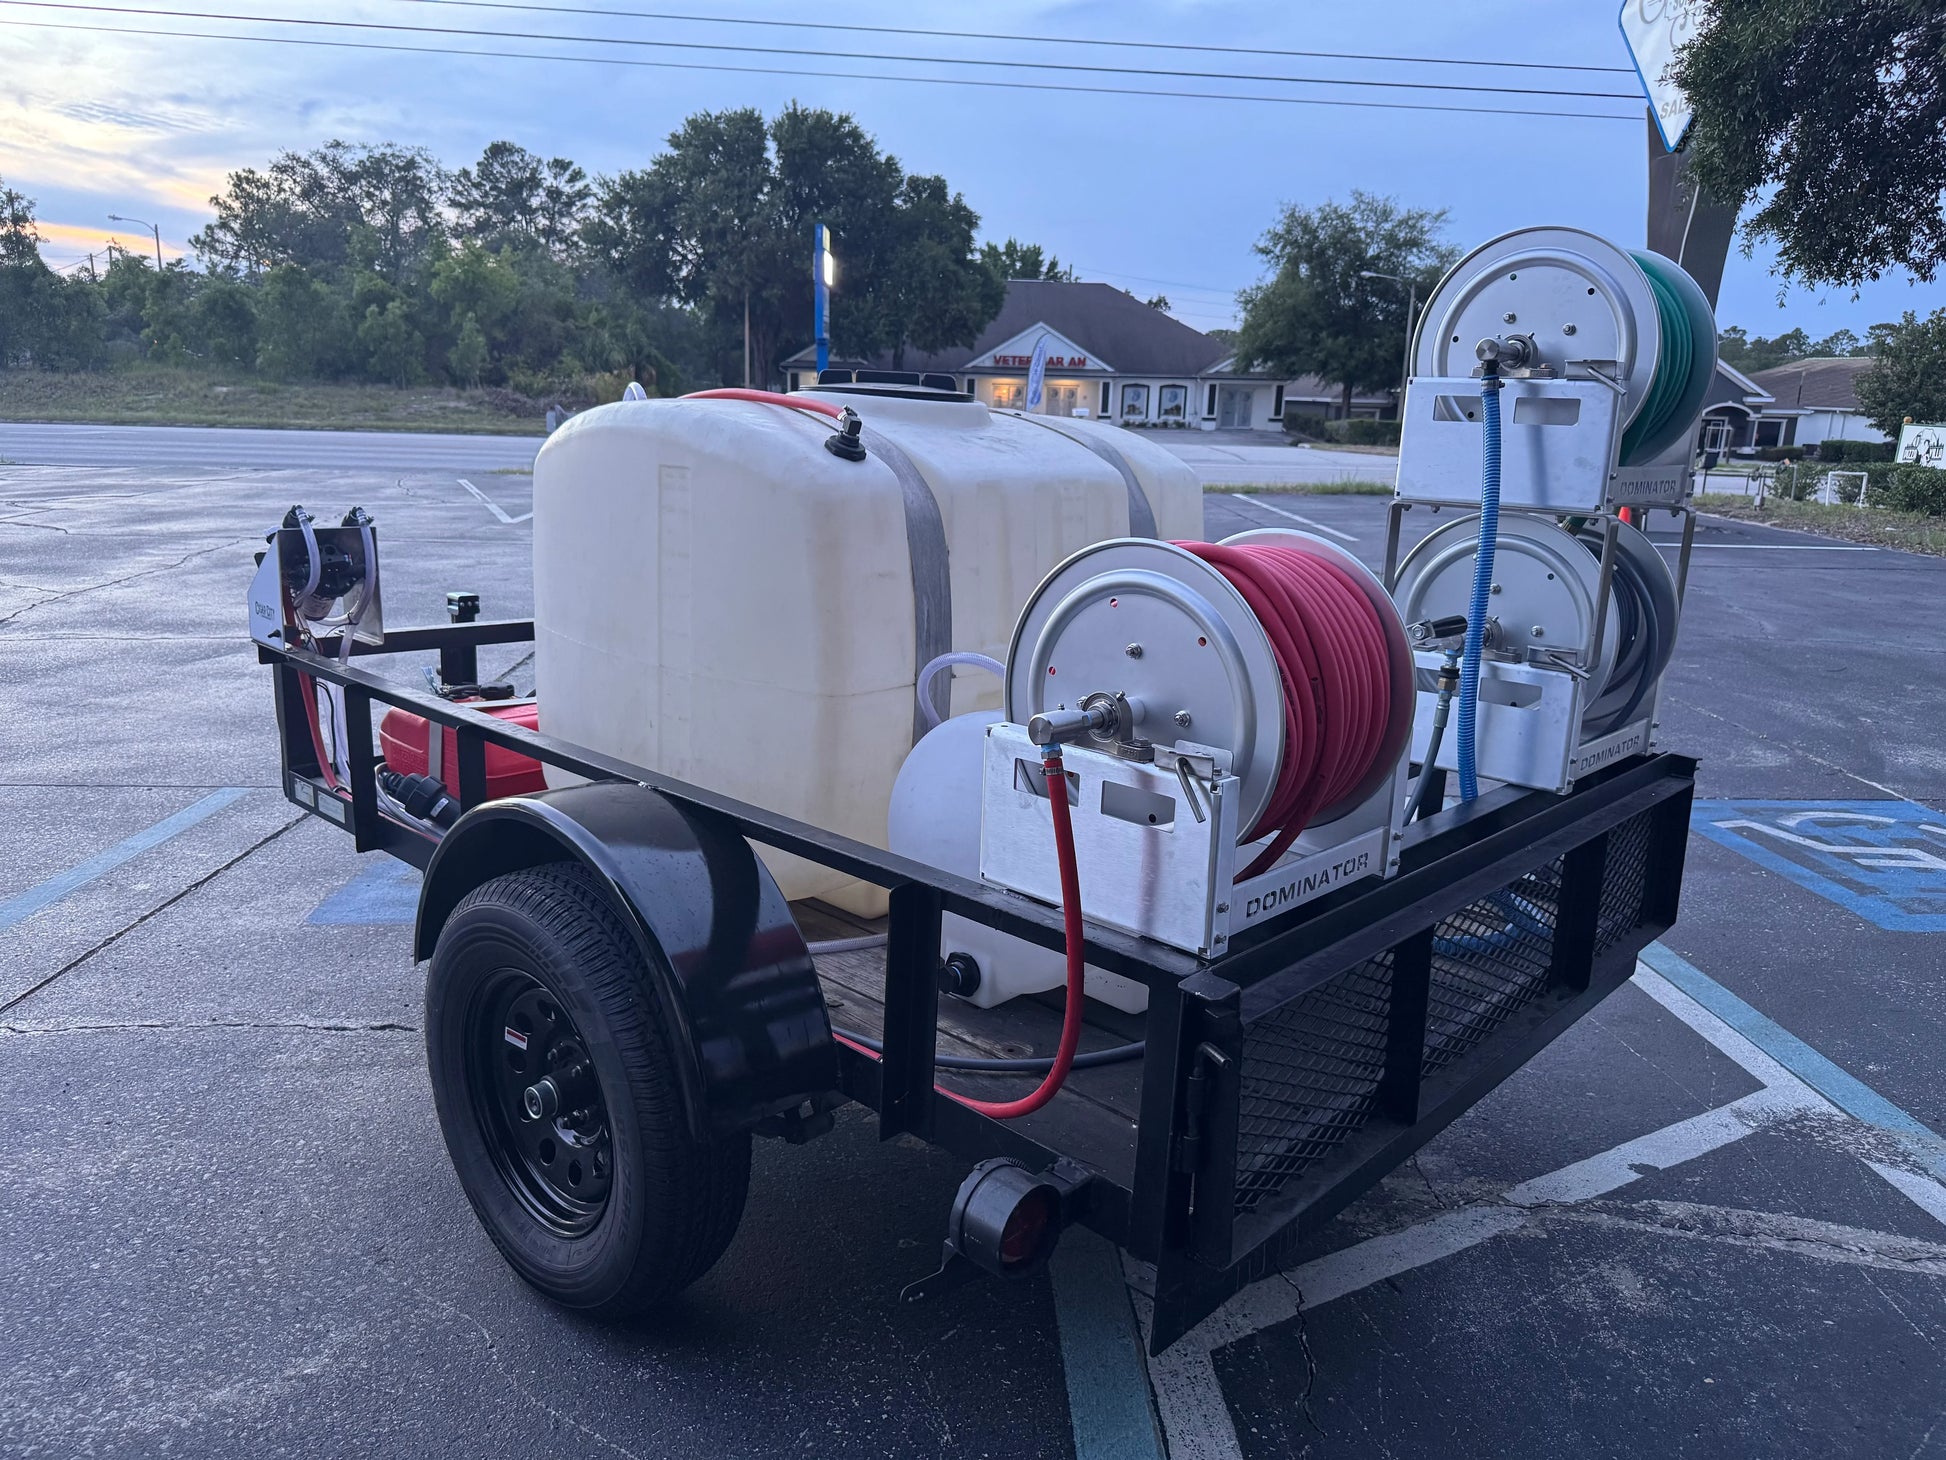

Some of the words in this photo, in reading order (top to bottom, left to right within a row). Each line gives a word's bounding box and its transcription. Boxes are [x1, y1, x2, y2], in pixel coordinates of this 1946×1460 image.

[1620, 479, 1676, 496] DOMINATOR
[1580, 735, 1640, 771] DOMINATOR
[1246, 852, 1369, 917] DOMINATOR
